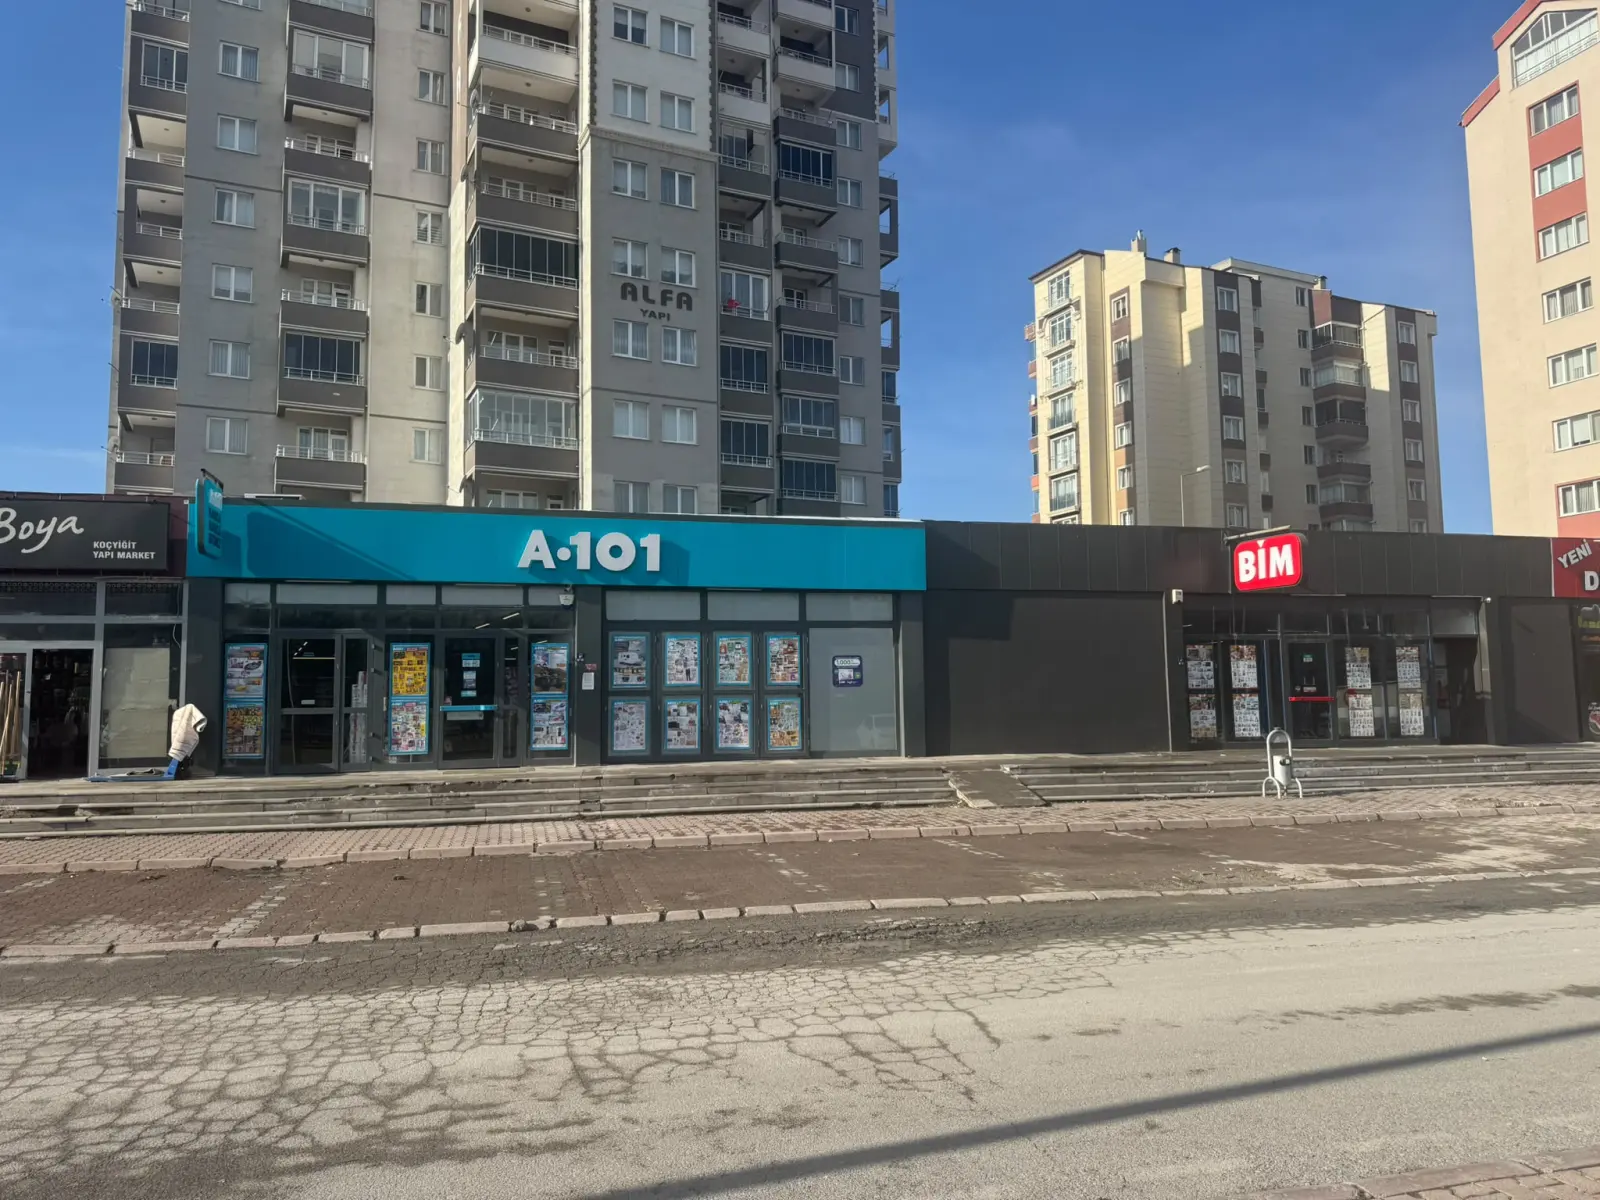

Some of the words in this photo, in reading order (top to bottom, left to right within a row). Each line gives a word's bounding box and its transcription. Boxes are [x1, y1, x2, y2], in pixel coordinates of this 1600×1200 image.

[620, 282, 693, 311] ALFA
[640, 308, 671, 322] YAPI
[93, 539, 137, 550] KOÇYİĞİT
[1557, 538, 1593, 569] YENİ
[93, 551, 114, 559] YAPI
[117, 551, 156, 560] MARKET
[1238, 539, 1295, 583] BİM
